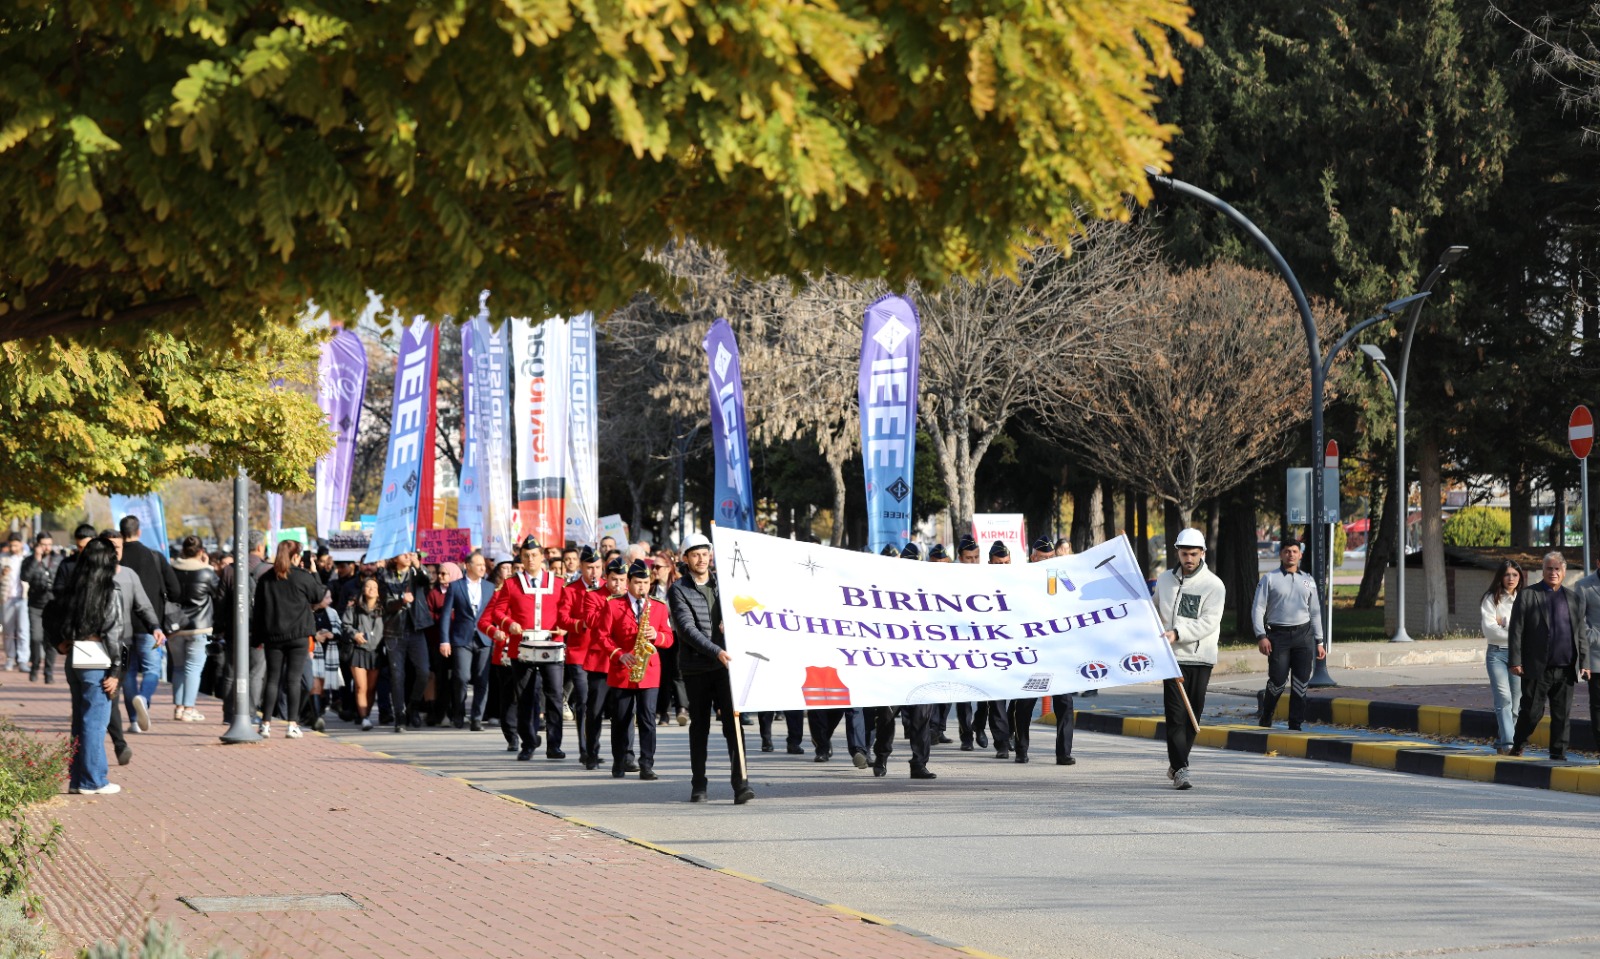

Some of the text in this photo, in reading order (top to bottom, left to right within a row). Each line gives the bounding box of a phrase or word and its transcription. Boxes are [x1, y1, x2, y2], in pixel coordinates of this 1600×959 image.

[392, 346, 428, 469] IEEE
[868, 357, 908, 470] IEEE
[981, 530, 1018, 539] KIRMIZI
[839, 584, 1012, 613] BİRİNCİ
[745, 603, 1130, 641] MÜHENDİSLİK RUHU
[839, 647, 1040, 671] YÜRÜYÜŞÜ
